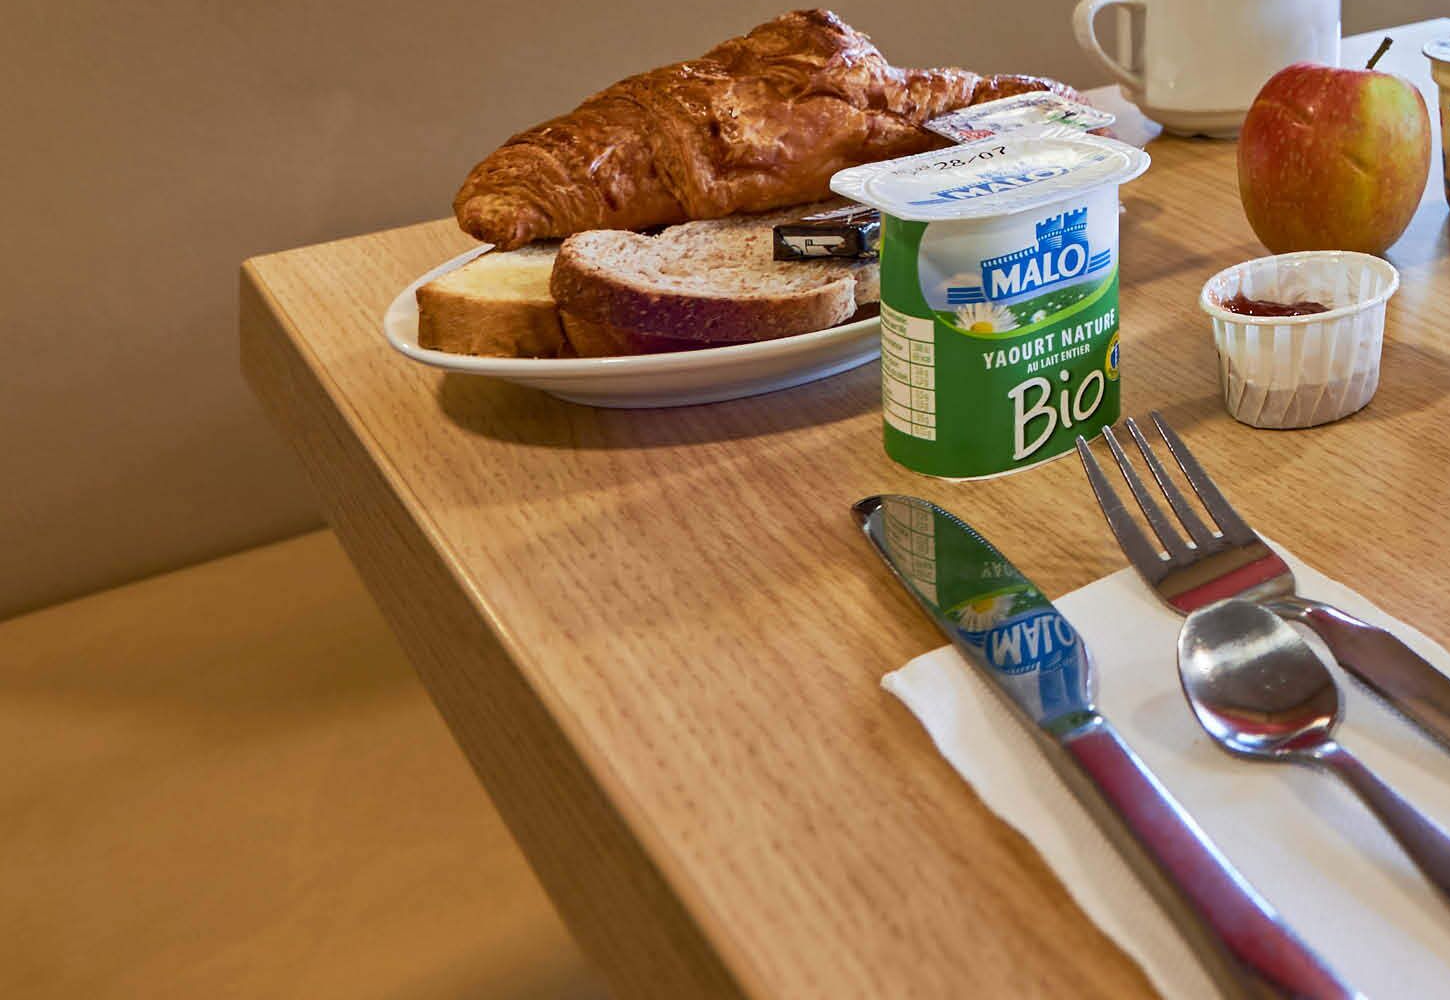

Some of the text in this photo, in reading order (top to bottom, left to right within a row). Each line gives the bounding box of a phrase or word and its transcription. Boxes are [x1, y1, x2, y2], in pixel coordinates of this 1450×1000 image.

[934, 146, 1007, 170] 28/07
[991, 244, 1086, 298] MALO
[983, 308, 1115, 370] YAOURT NATURE
[1027, 343, 1090, 374] AU LAIT ENTIER
[1008, 369, 1105, 460] Bio
